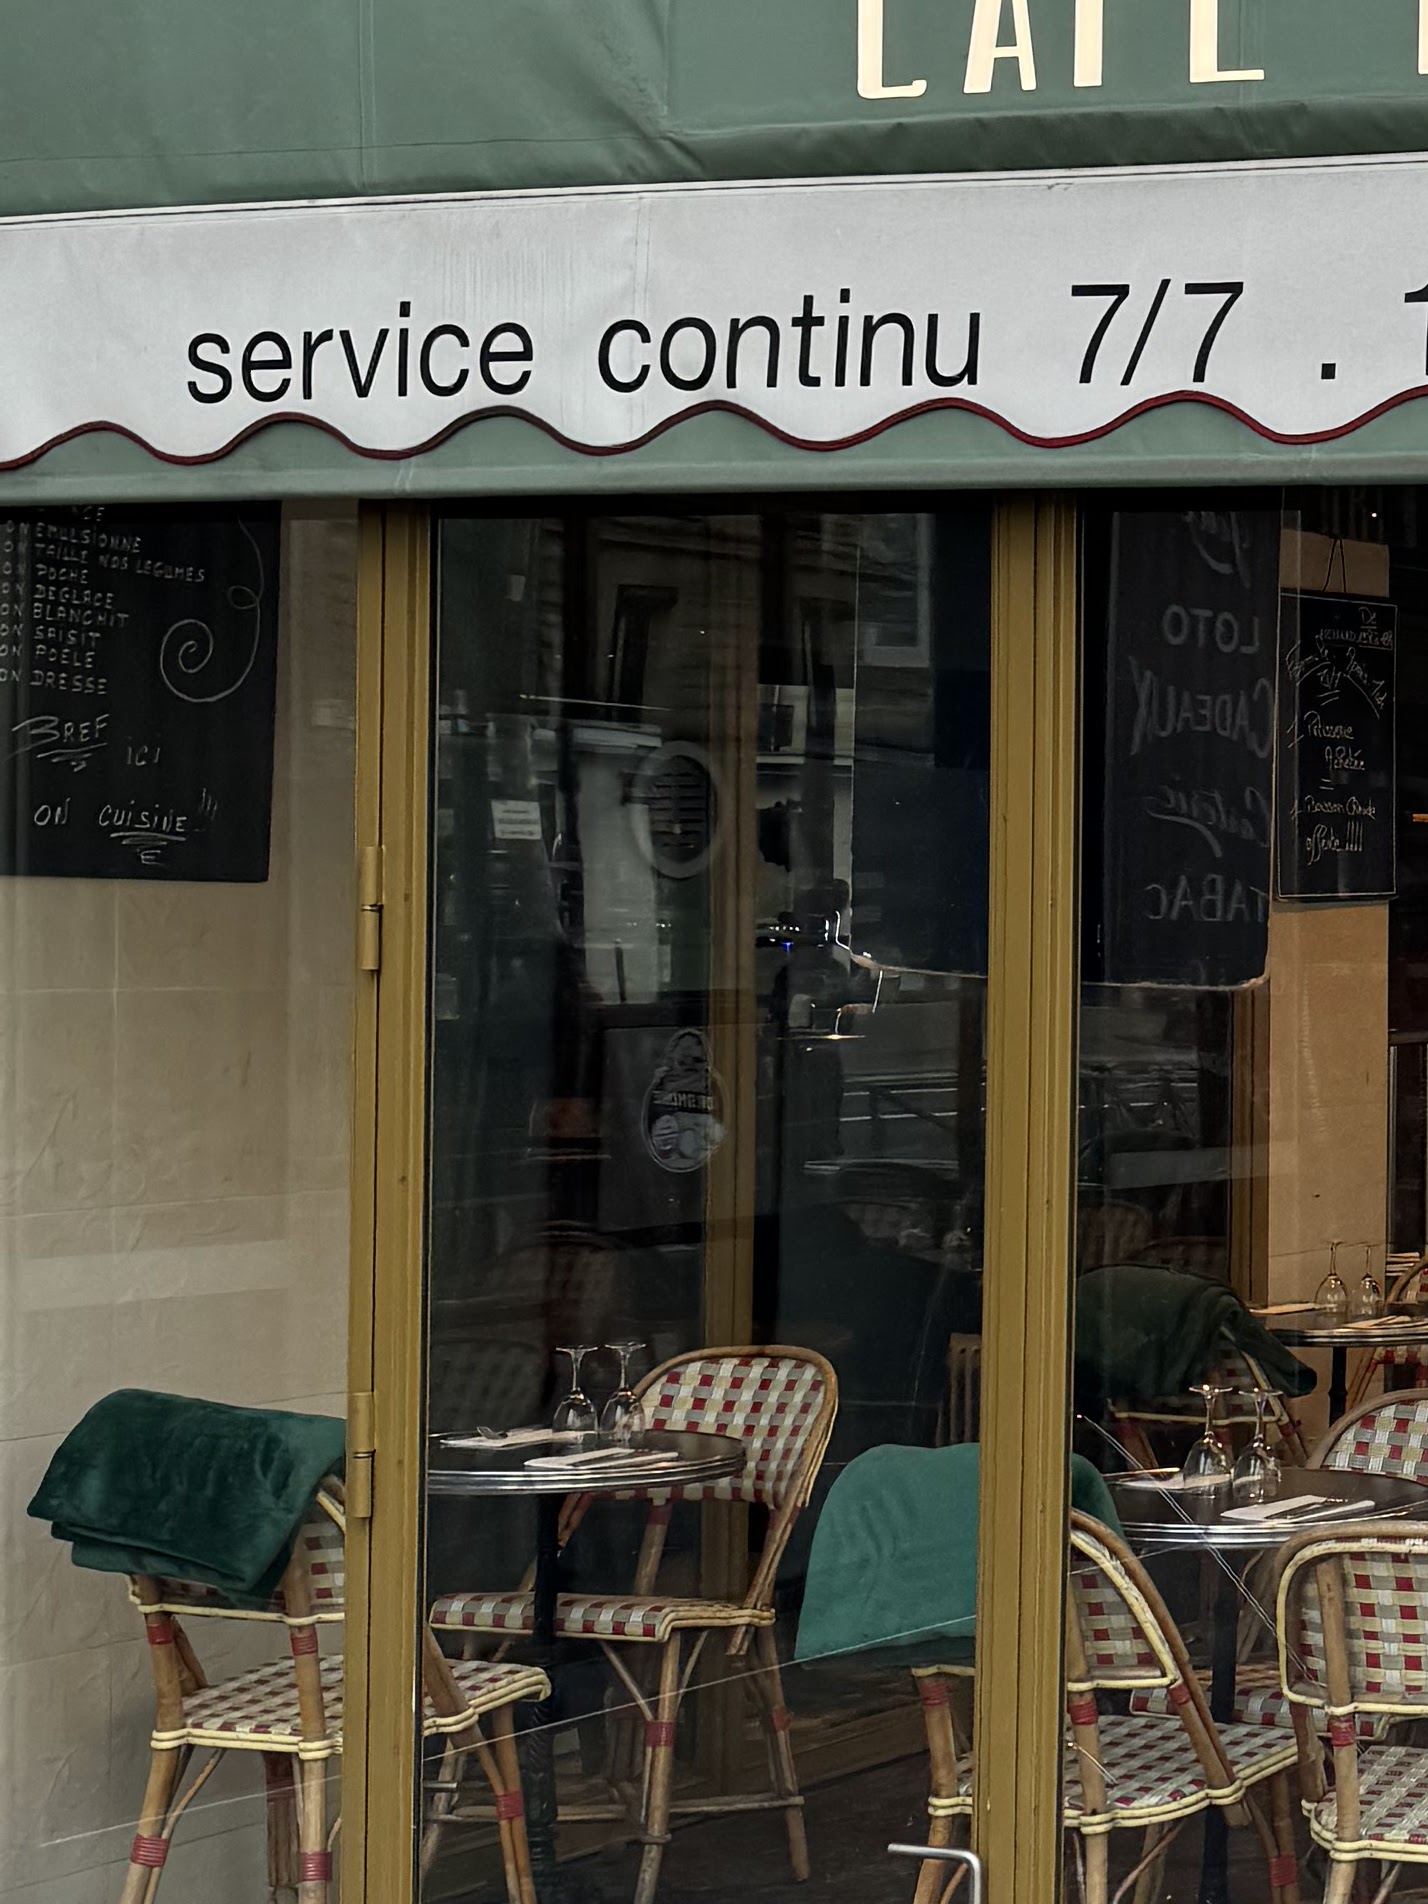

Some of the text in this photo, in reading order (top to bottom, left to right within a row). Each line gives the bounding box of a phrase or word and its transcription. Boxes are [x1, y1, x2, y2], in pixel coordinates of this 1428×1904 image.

[186, 300, 535, 405] service
[598, 289, 982, 394] continu
[1070, 277, 1245, 387] 7/7
[33, 626, 101, 647] SAISIT
[30, 669, 108, 695] DRESSE
[8, 713, 110, 751] BREF
[33, 797, 71, 826] ON
